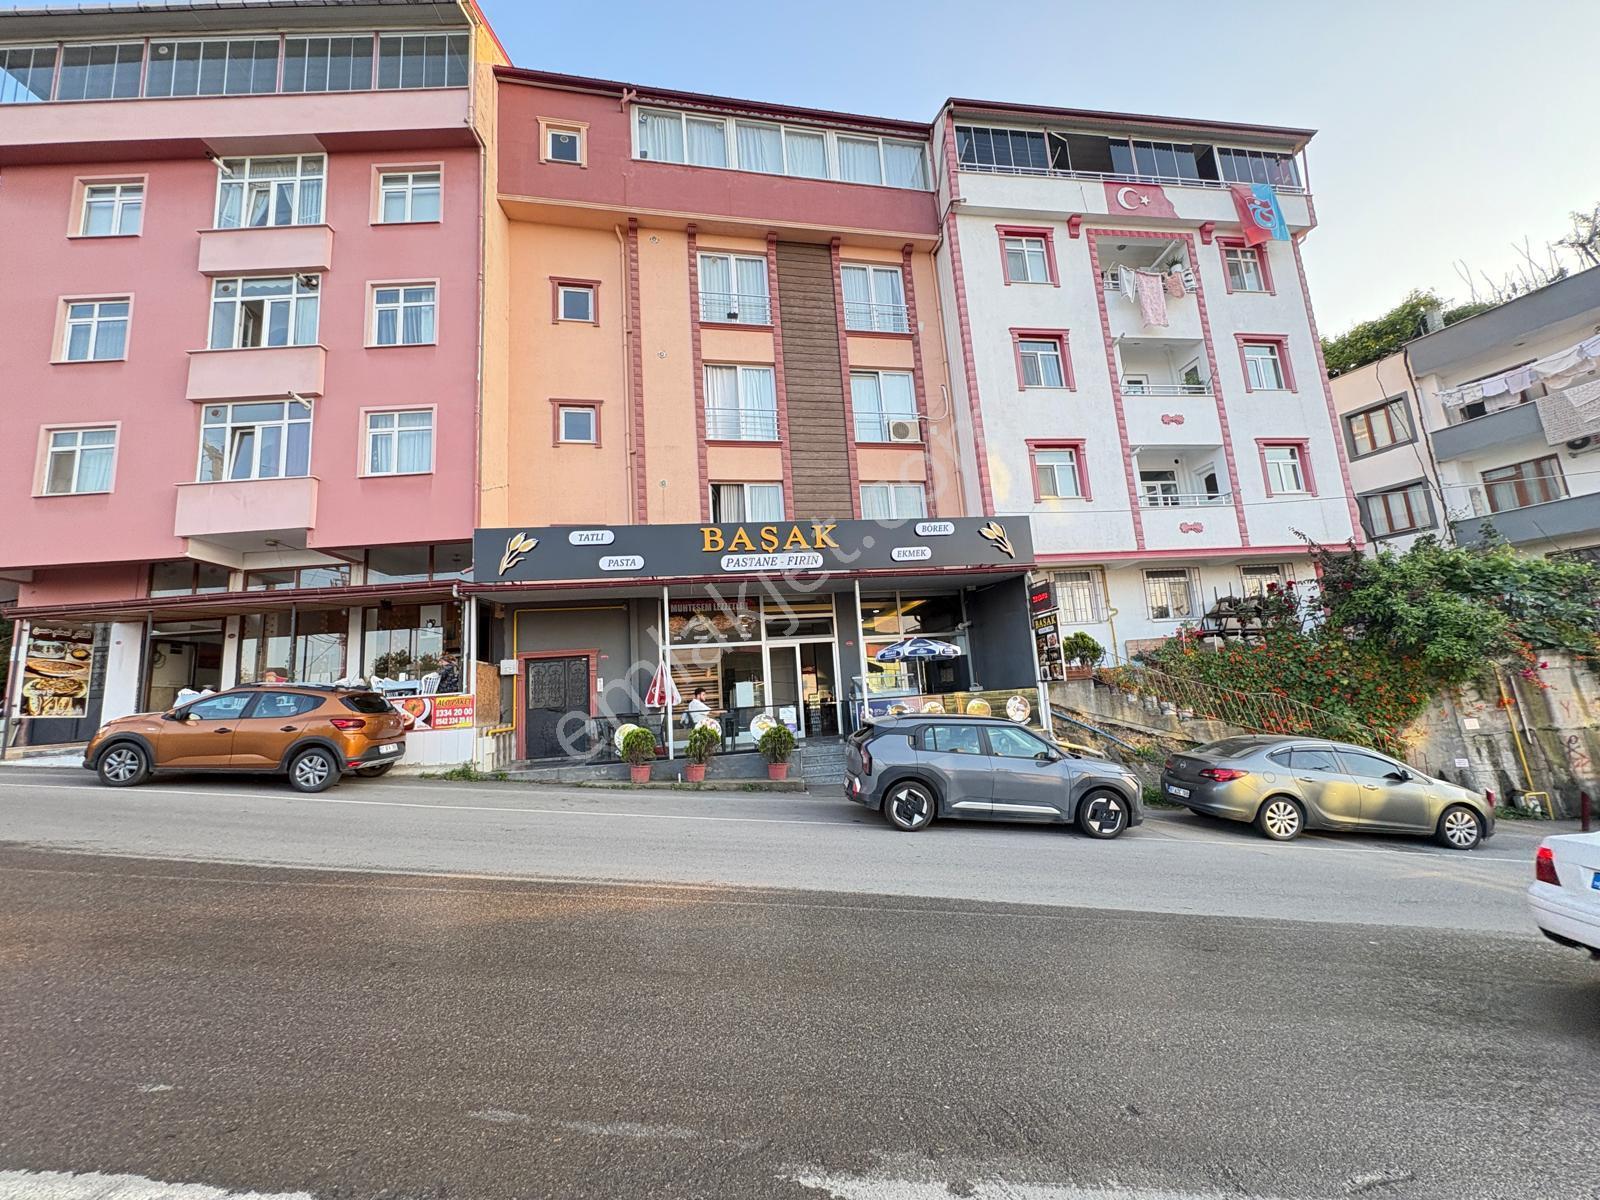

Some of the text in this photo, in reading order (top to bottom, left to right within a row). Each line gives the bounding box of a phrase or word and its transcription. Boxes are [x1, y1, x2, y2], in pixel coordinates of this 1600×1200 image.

[578, 533, 605, 542] TATLI
[700, 524, 839, 553] BAŞAK
[897, 549, 927, 558] EKMEK
[607, 558, 637, 568] PASTA
[725, 556, 778, 568] PASTANE
[786, 555, 820, 566] FIRIN
